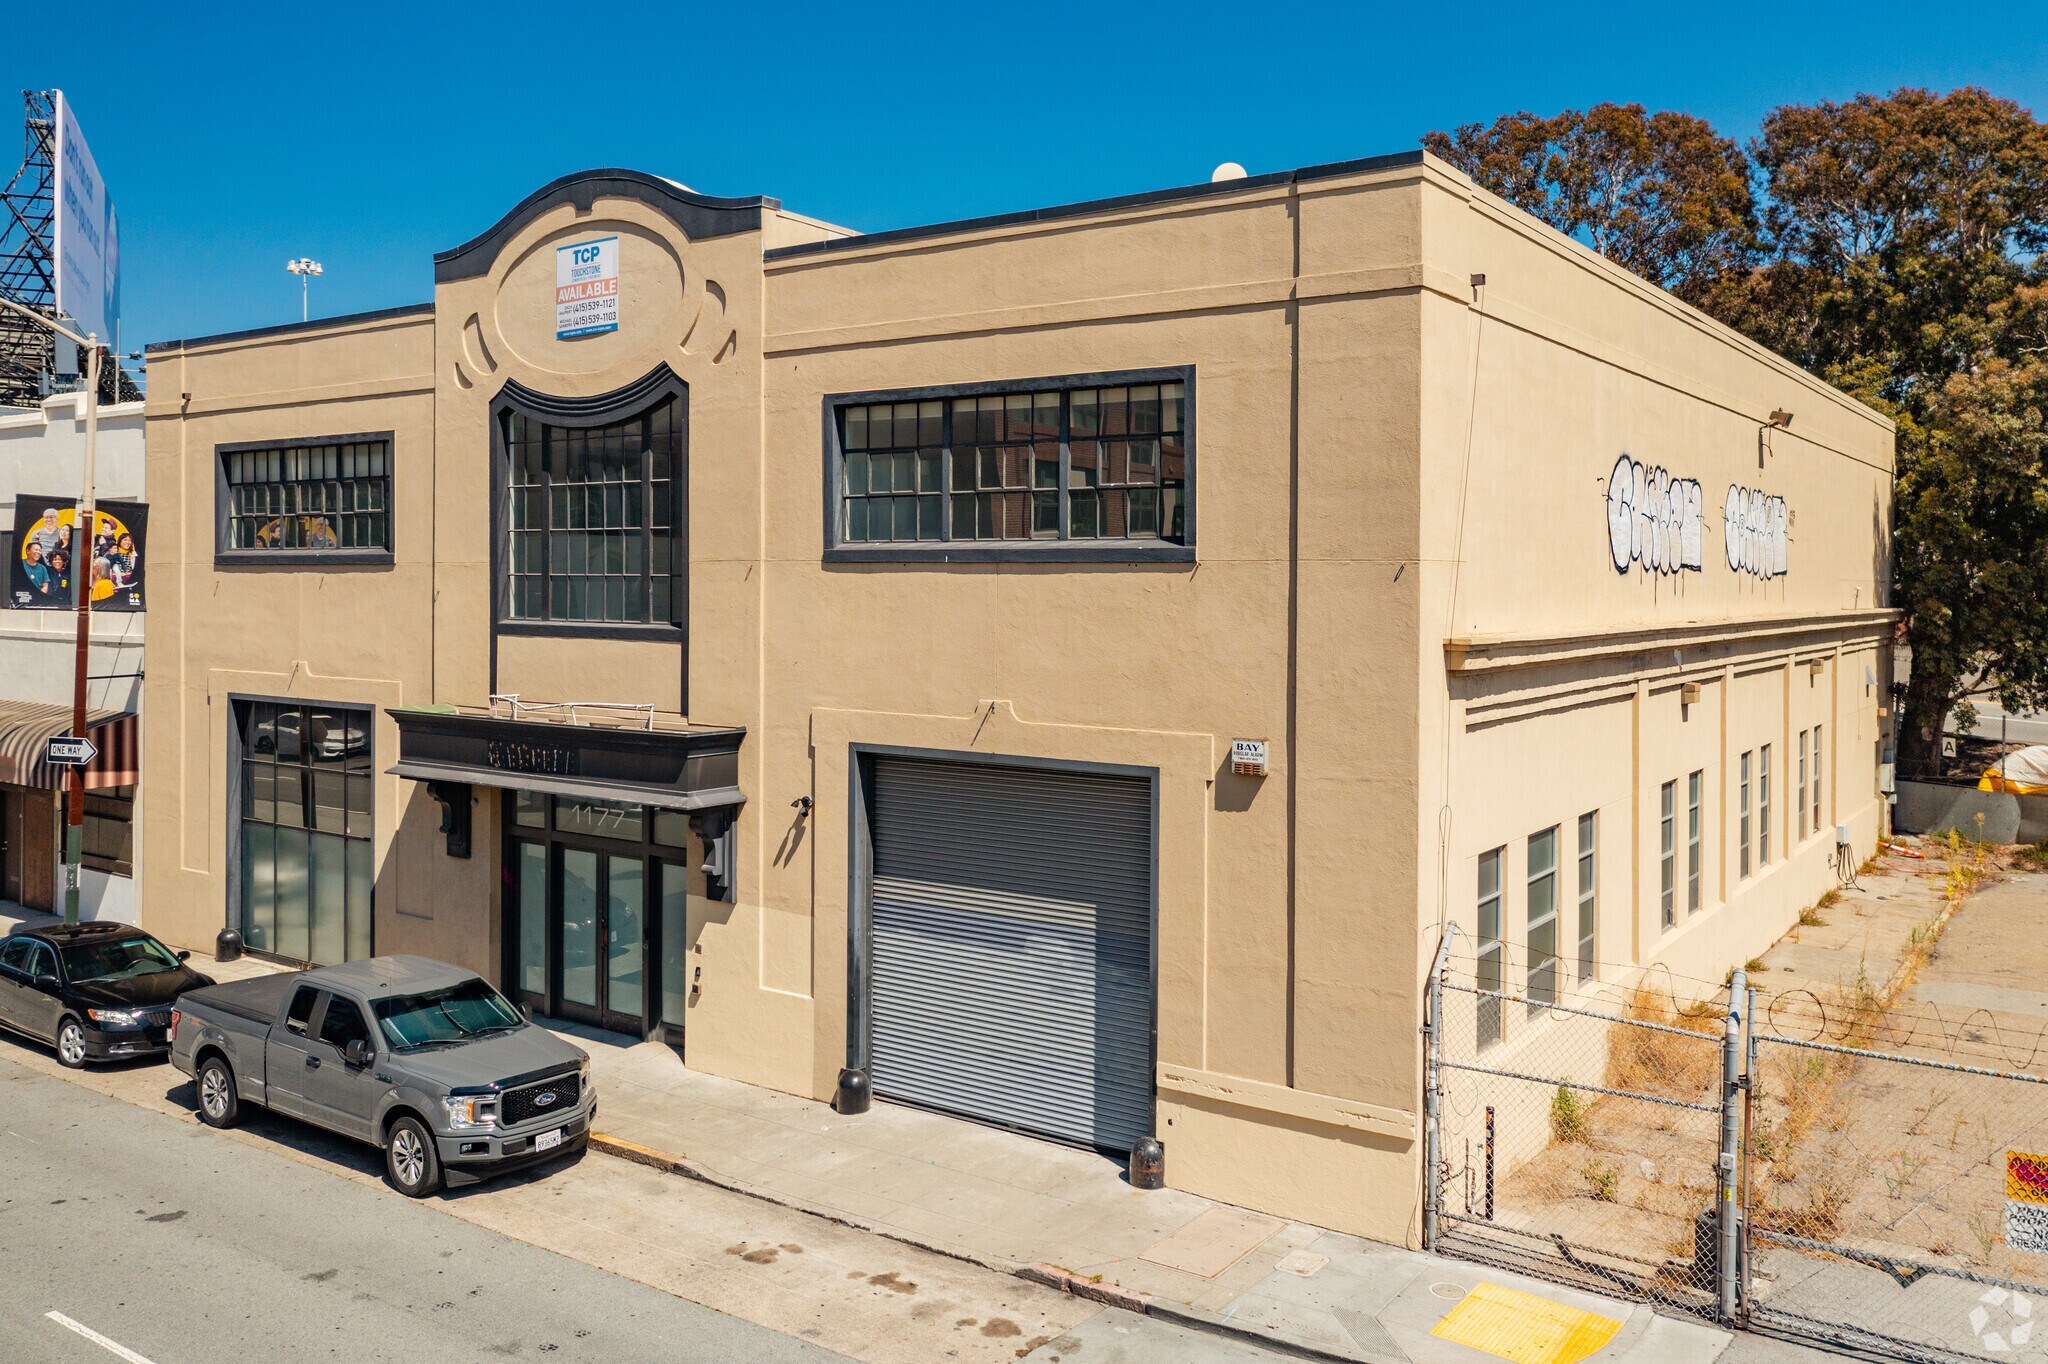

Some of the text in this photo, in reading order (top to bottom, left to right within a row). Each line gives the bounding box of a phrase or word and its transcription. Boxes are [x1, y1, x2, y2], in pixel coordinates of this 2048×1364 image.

[573, 246, 600, 265] TCP
[571, 265, 601, 278] TOUCHSTONE
[558, 280, 617, 303] AVAILABLE
[572, 302, 587, 314] (415)
[588, 298, 616, 311] 539-1121
[572, 315, 587, 327] (415)
[588, 311, 617, 324] 539-1103
[52, 745, 82, 756] ONE WAY
[1237, 743, 1260, 752] BAY
[1944, 741, 1955, 753] A
[571, 804, 625, 829] 1177
